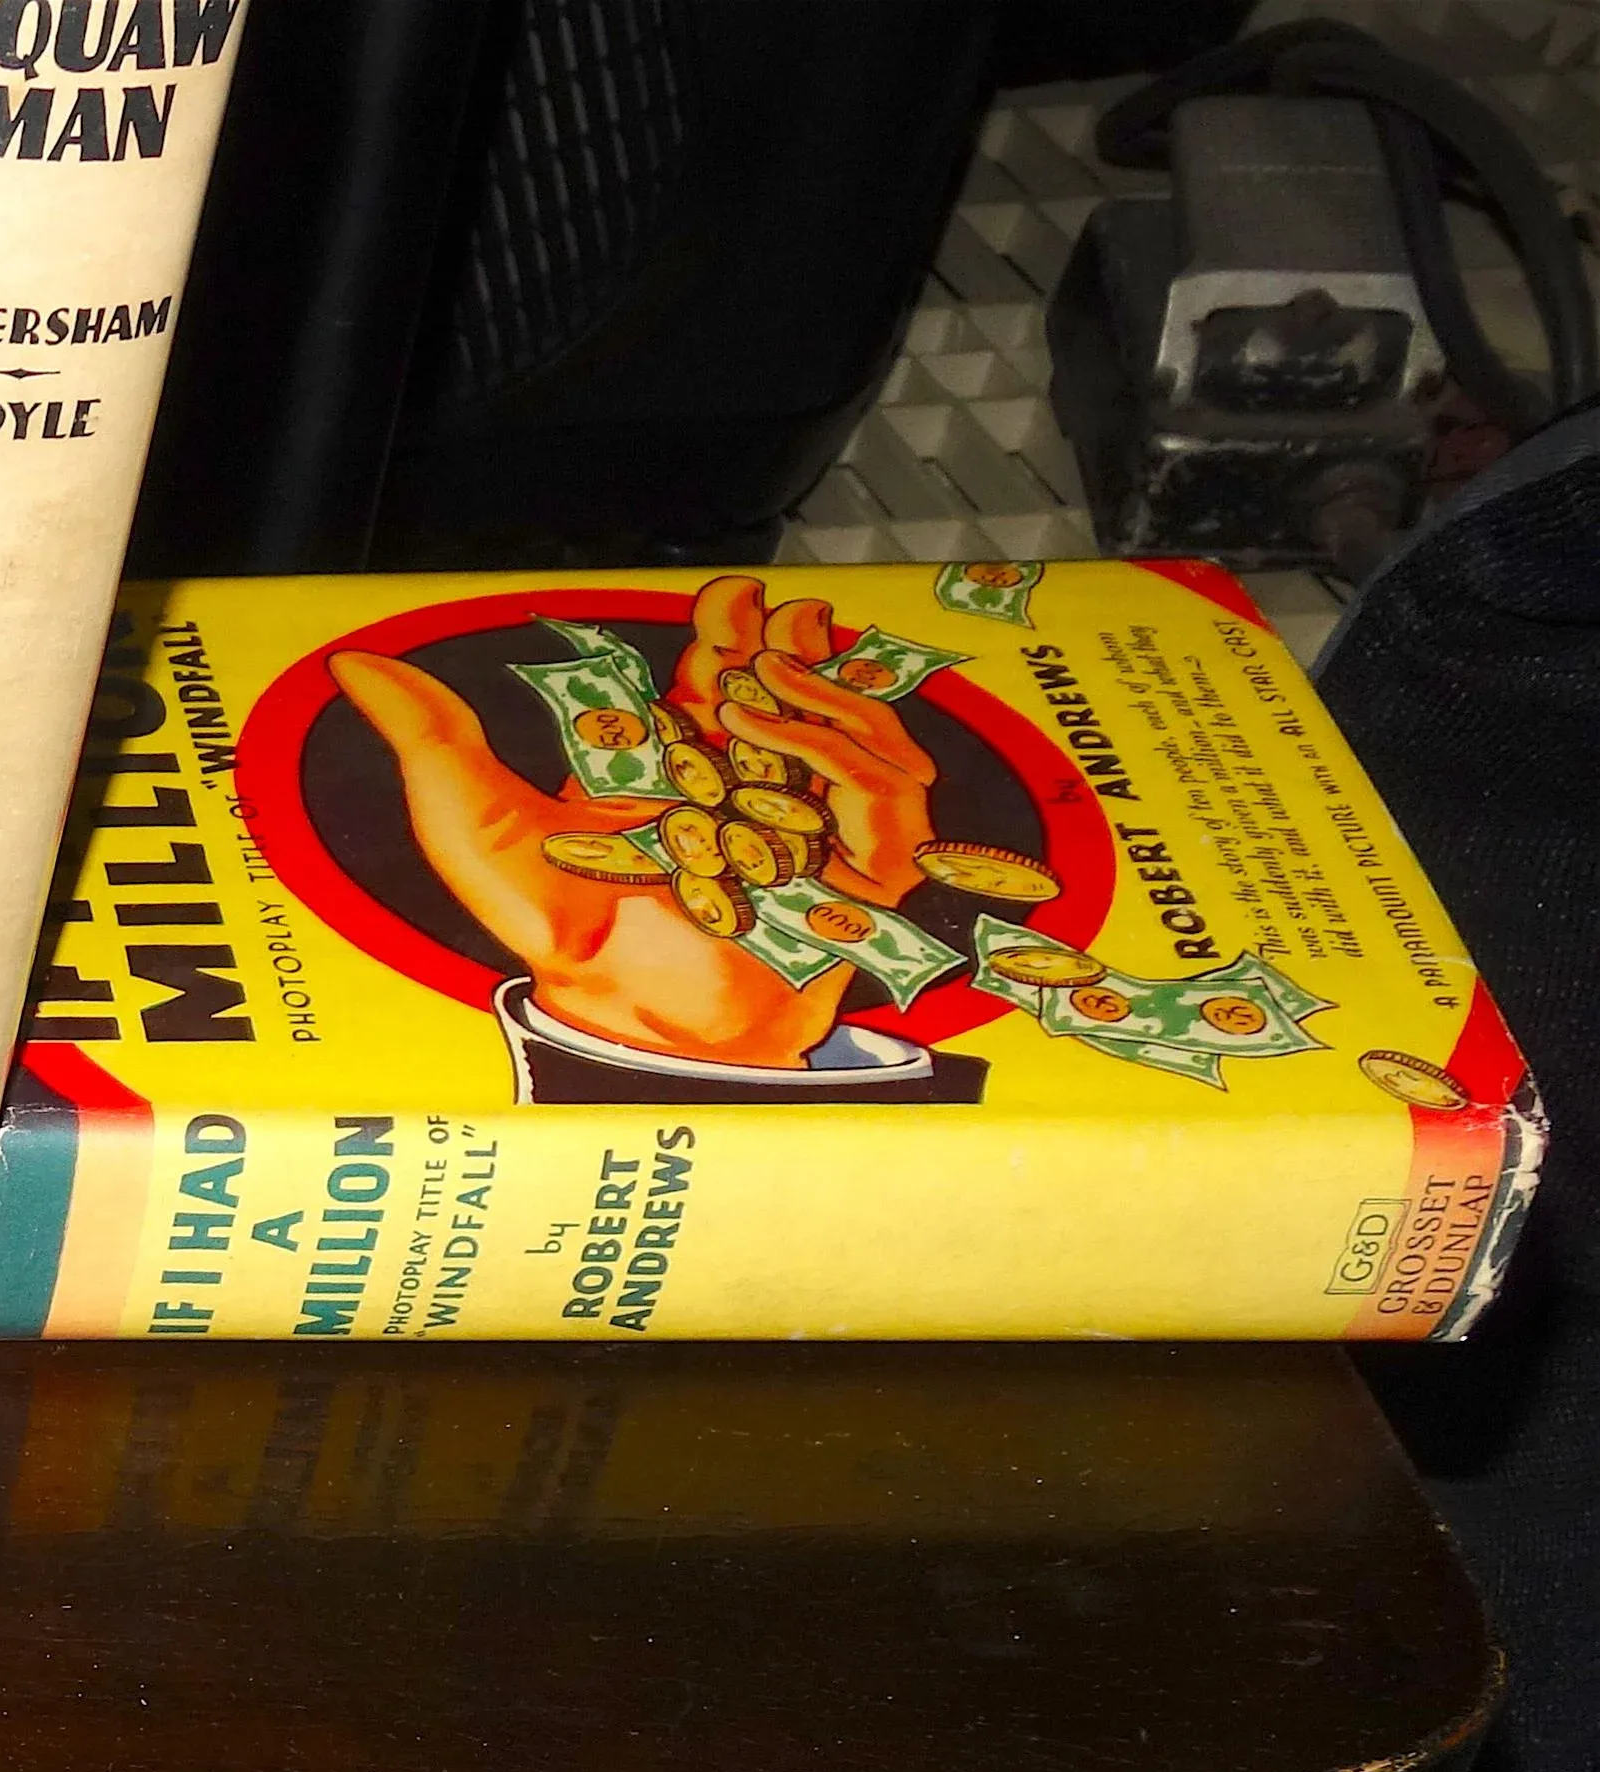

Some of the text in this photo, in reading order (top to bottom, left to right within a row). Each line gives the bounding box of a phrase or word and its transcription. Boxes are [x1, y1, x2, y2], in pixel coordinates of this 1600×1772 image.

[1213, 616, 1257, 659] CAST
[1240, 664, 1286, 704] STAR
[1271, 708, 1308, 738] ALL
[225, 794, 259, 820] OF
[245, 822, 280, 885] TITLE
[1028, 643, 1223, 962] ROBERT ANDREWS
[1326, 803, 1385, 868] PICTURE
[260, 899, 320, 1044] PHOTOPLAY
[147, 1113, 248, 1337] IF I HAD
[251, 1209, 304, 1251] A
[292, 1114, 395, 1336] MILLION
[382, 1114, 448, 1336] PHOTOPLAY TITLE OF
[525, 1221, 580, 1255] by
[561, 1149, 644, 1319] ROBERT
[608, 1124, 696, 1332] ANDREWS
[1340, 1213, 1391, 1282] G&D
[1378, 1172, 1456, 1315] GROSSET
[1413, 1172, 1494, 1317] & DUNLAP
